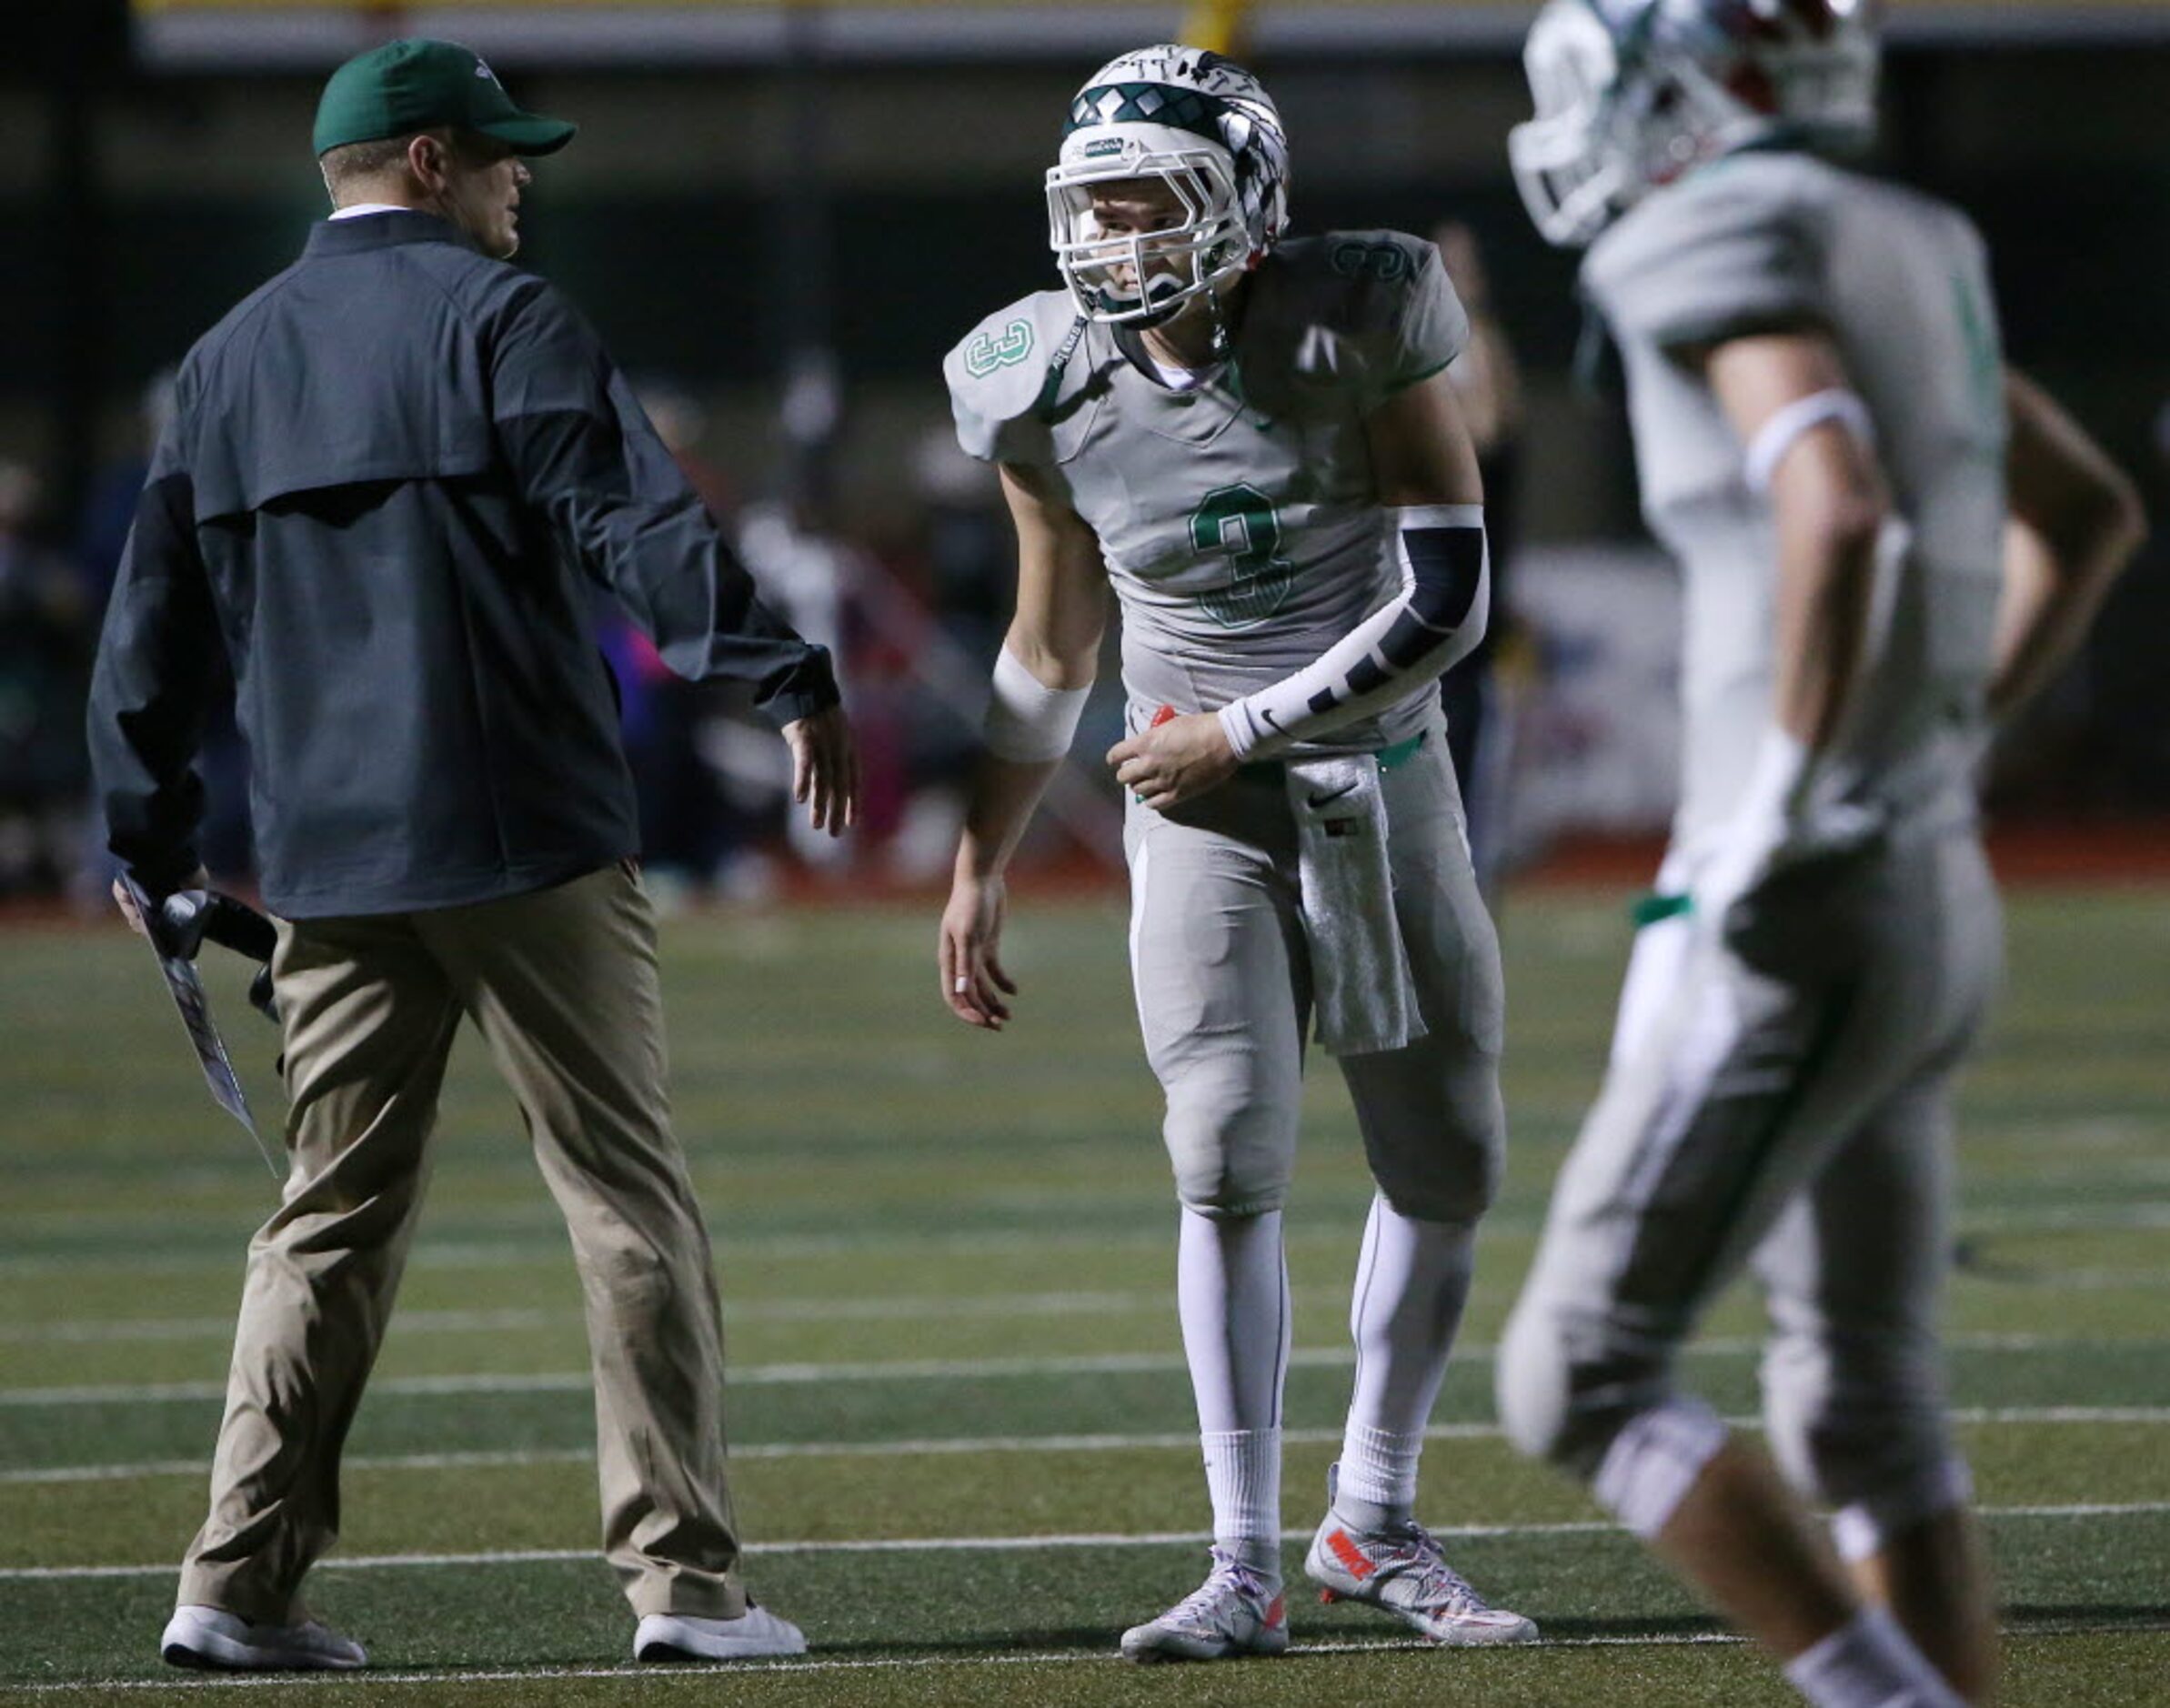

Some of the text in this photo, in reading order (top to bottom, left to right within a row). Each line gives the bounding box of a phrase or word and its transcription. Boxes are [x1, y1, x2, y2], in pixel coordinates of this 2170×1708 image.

[1331, 240, 1408, 283] 3
[965, 318, 1034, 379] 3
[1189, 481, 1292, 629] 3
